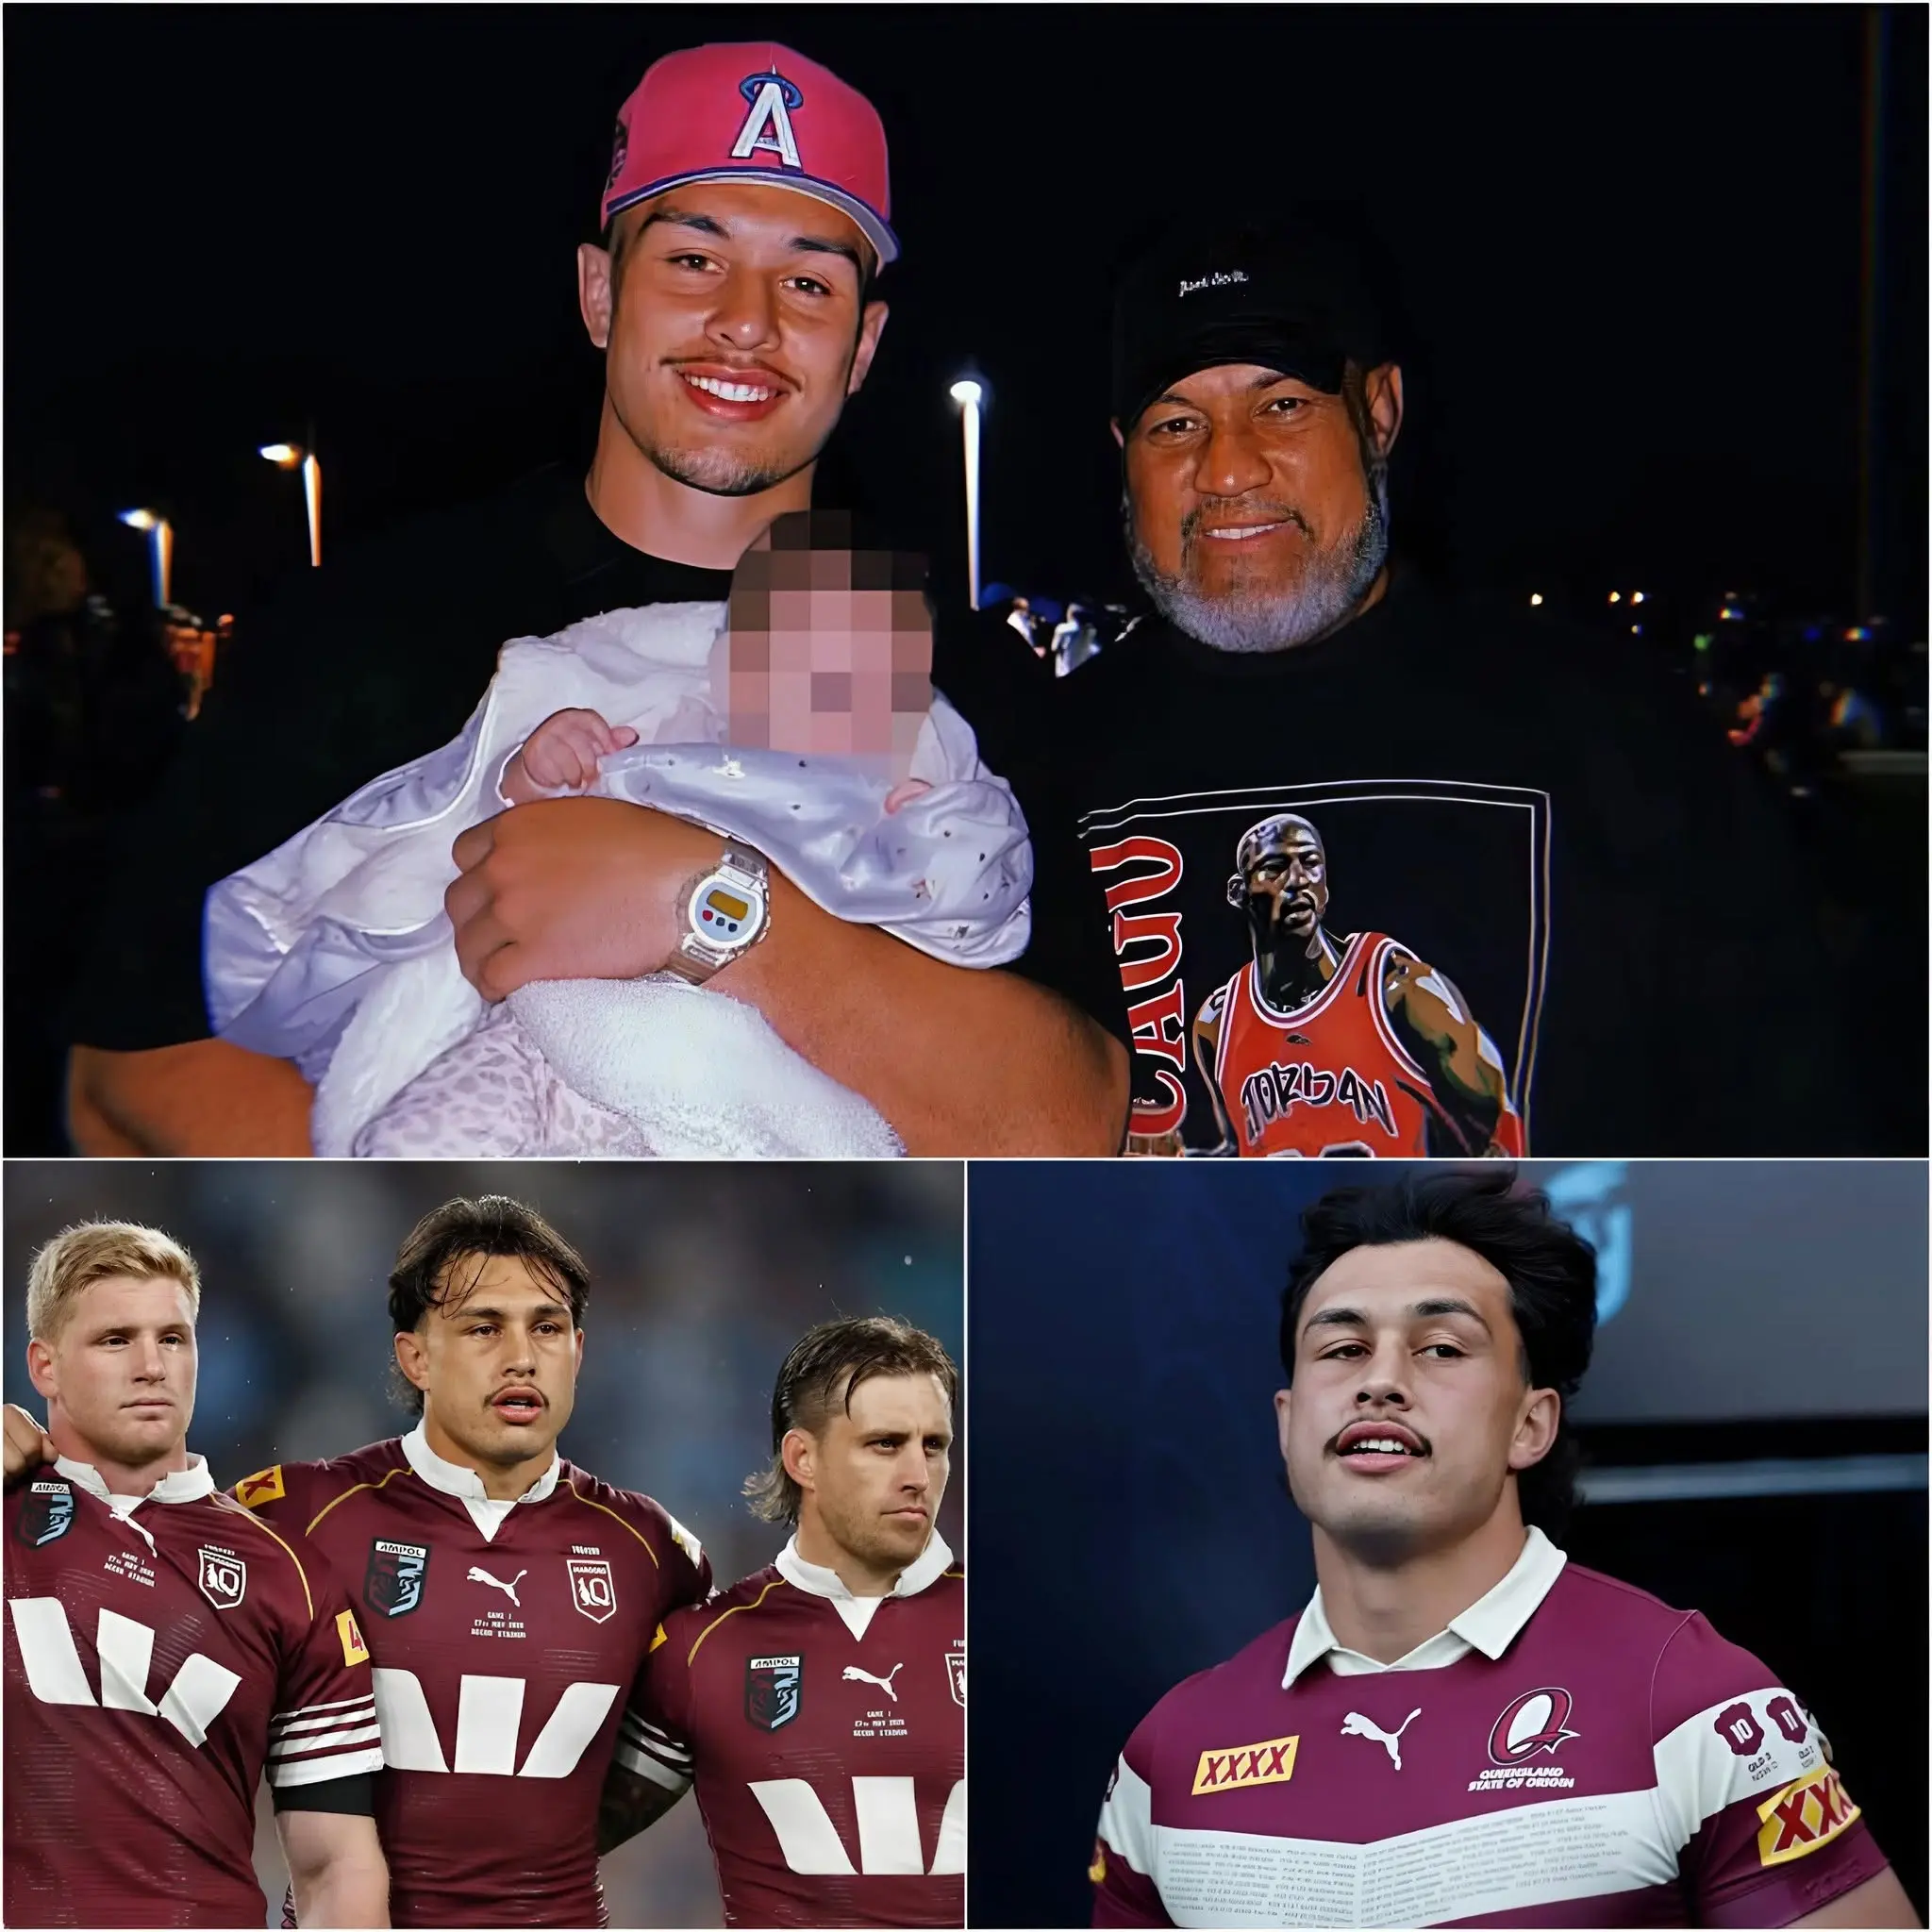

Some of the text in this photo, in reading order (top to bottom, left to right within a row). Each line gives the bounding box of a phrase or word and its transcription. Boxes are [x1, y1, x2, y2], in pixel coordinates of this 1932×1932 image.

[730, 79, 803, 170] A
[1241, 1061, 1399, 1146] JORDAN
[380, 1543, 423, 1557] AMPOL
[1729, 1718, 1754, 1744] 10
[1200, 1743, 1291, 1788] XXXX
[1506, 1778, 1524, 1789] OF
[1525, 1777, 1575, 1789] ORIGIN
